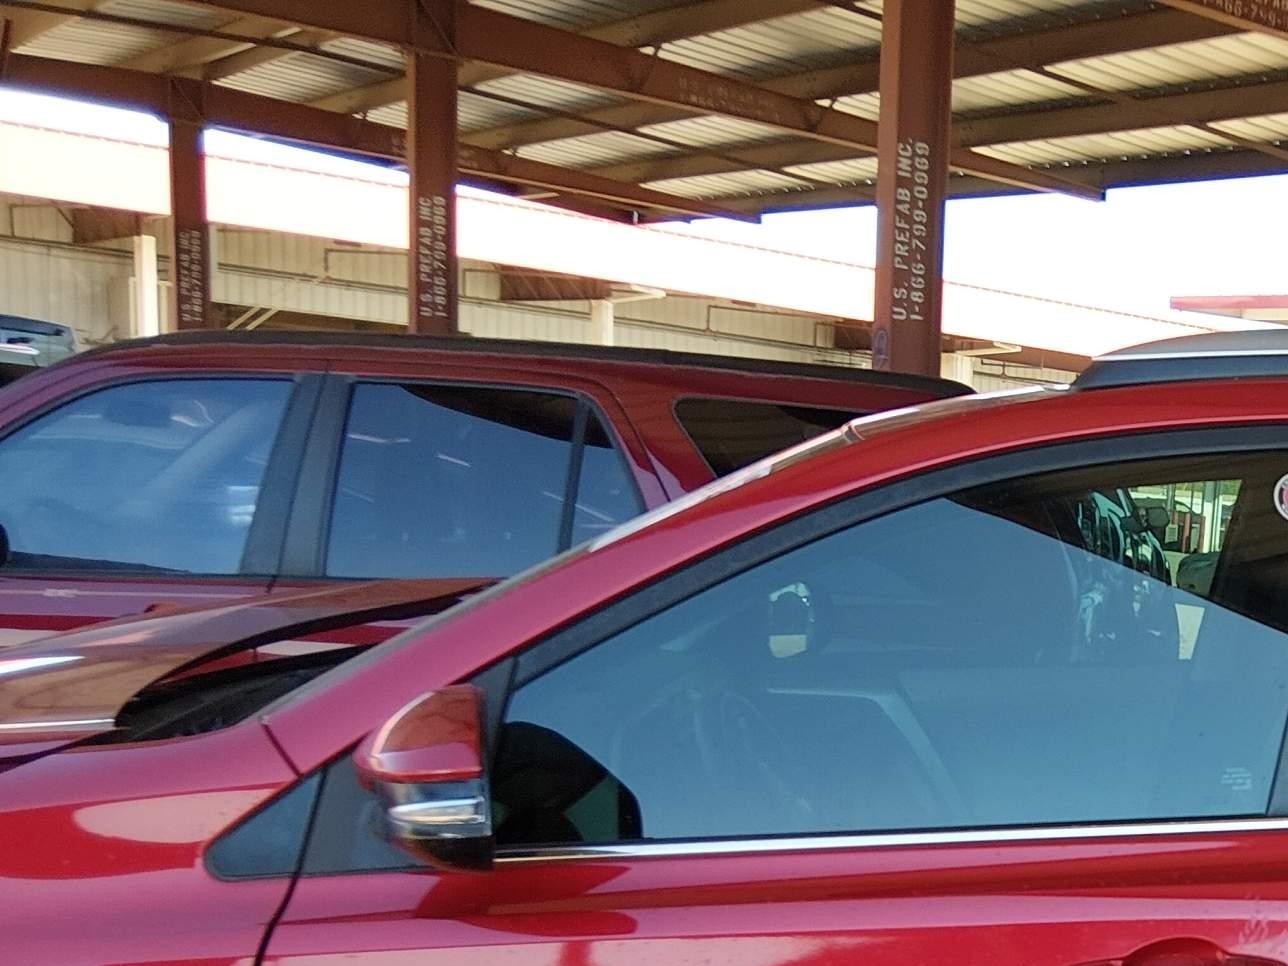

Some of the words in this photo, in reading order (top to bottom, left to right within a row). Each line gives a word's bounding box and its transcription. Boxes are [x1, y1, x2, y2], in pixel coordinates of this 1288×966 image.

[897, 137, 913, 179] INC.
[419, 227, 432, 283] PREFAB
[894, 188, 911, 270] PREFAB
[910, 141, 930, 321] 1-866-799-0969
[892, 281, 908, 321] U.S.
